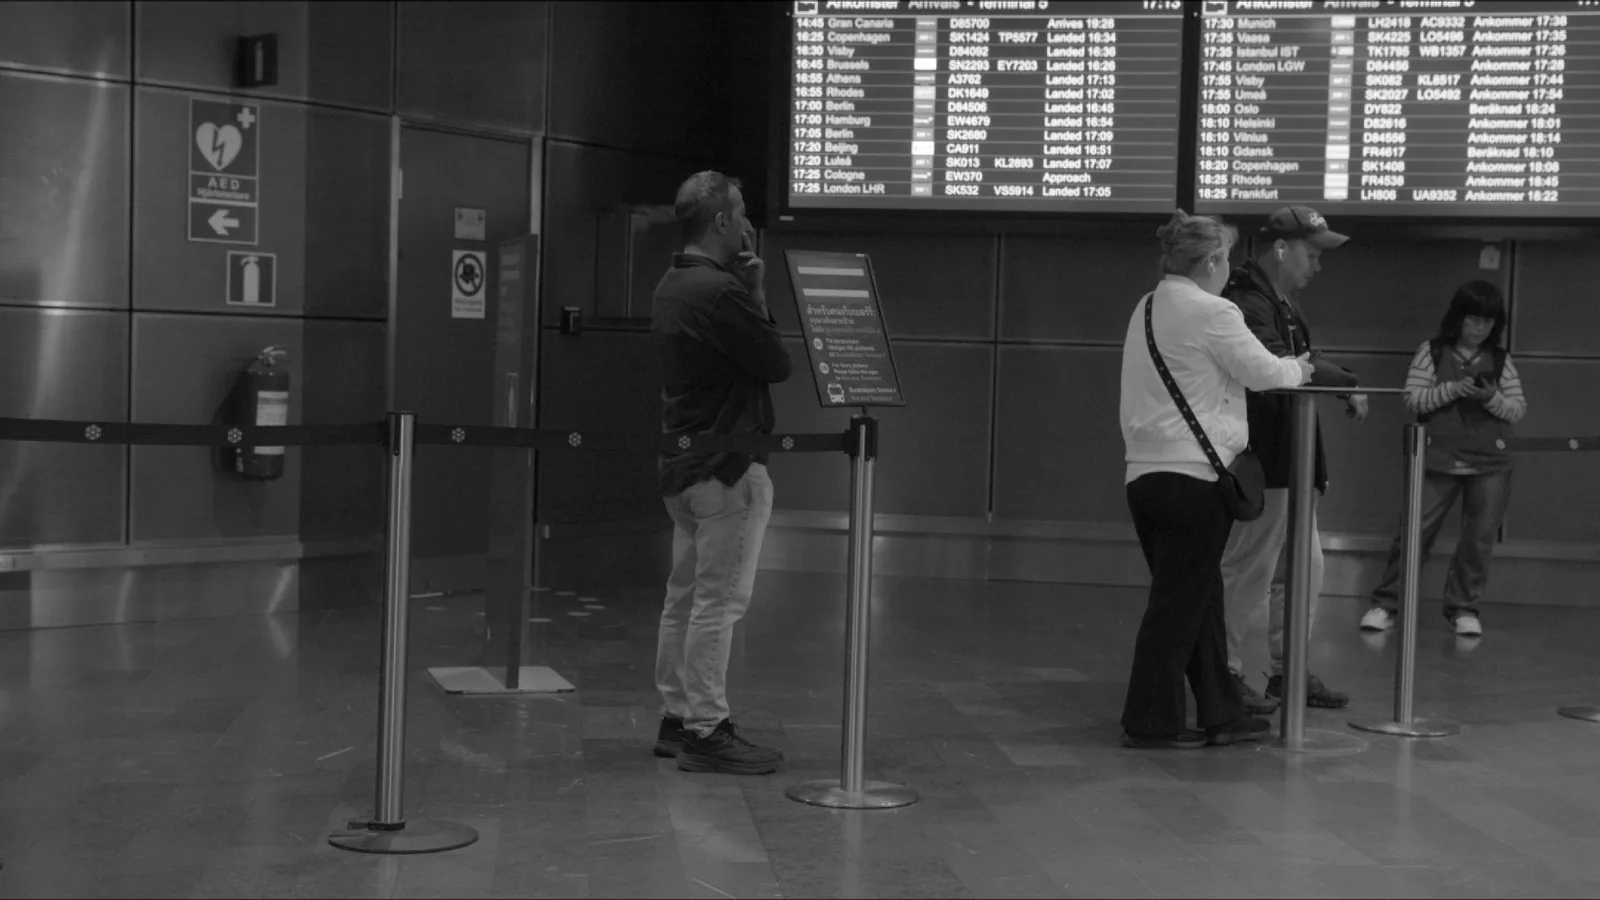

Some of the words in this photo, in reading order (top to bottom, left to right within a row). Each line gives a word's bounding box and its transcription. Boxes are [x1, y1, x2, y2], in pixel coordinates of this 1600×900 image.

[797, 18, 824, 28] 14:45
[828, 18, 852, 28] Gran
[855, 18, 893, 28] Canaria
[1048, 19, 1083, 29] Arrives
[1205, 18, 1234, 29] 17:30
[1238, 18, 1275, 29] Munich
[1474, 16, 1533, 27] Ankommer
[797, 31, 824, 41] 16:25
[828, 32, 890, 44] Copenhagen
[950, 32, 989, 43] SK1424
[1047, 33, 1084, 43] Landed
[1089, 32, 1116, 43] 16:34
[1205, 32, 1233, 43] 17:35
[1237, 32, 1270, 43] Vaasa
[1473, 31, 1533, 41] Ankommer
[797, 45, 824, 55] 16:30
[827, 46, 854, 58] Visby
[1047, 47, 1084, 57] Landed
[1204, 46, 1232, 57] 17:35
[1237, 47, 1277, 57] Istanbul
[1279, 46, 1299, 57] IST
[1472, 45, 1534, 56] Ankommer
[796, 59, 823, 69] 16:45
[827, 59, 869, 70] Brussels
[1047, 61, 1084, 71] Landed
[1204, 61, 1232, 71] 17:45
[1236, 61, 1275, 72] London
[1278, 60, 1305, 72] LGW
[1471, 60, 1531, 71] Ankommer
[796, 73, 823, 83] 16:55
[826, 73, 861, 83] Athens
[1046, 75, 1084, 85] Landed
[1087, 74, 1115, 85] 17:13
[1203, 75, 1231, 86] 17:55
[1235, 75, 1264, 87] Visby
[1471, 75, 1530, 85] Ankommer
[1534, 74, 1563, 85] 17:44
[796, 87, 822, 97] 16:55
[826, 87, 864, 97] Rhodes
[1046, 89, 1083, 99] Landed
[1087, 88, 1114, 99] 17:02
[1203, 89, 1231, 100] 17:55
[1235, 90, 1266, 100] Umeå
[1470, 89, 1530, 100] Ankommer
[1533, 88, 1563, 100] 17:54
[796, 100, 822, 111] 17:00
[826, 101, 854, 111] Berlin
[1045, 103, 1083, 113] Landed
[1087, 103, 1114, 113] 16:45
[1202, 104, 1230, 114] 18:00
[1235, 103, 1259, 114] Oslo
[1469, 104, 1522, 114] Beräknad
[795, 114, 822, 124] 17:00
[826, 115, 871, 128] Hamburg
[1045, 117, 1082, 127] Landed
[1086, 117, 1113, 127] 16:54
[1201, 118, 1229, 128] 18:10
[1234, 118, 1275, 128] Helsinki
[1469, 118, 1531, 129] Ankommer
[1531, 118, 1560, 129] 18:01
[795, 128, 821, 138] 17:05
[825, 128, 853, 138] Berlin
[1044, 131, 1082, 141] Landed
[1085, 131, 1113, 141] 17:09
[1201, 132, 1229, 142] 18:10
[1234, 132, 1268, 142] Vilnius
[1468, 133, 1530, 143] Ankommer
[1531, 132, 1560, 144] 18:14
[795, 141, 821, 152] 17:20
[825, 142, 858, 154] Beijing
[947, 144, 978, 153] CA911
[1044, 145, 1081, 155] Landed
[1085, 145, 1111, 155] 16:51
[1201, 146, 1229, 156] 18:10
[1233, 146, 1273, 156] Gdansk
[1468, 147, 1520, 158] Beräknad
[1523, 147, 1553, 158] 18:10
[794, 155, 821, 165] 17:20
[825, 156, 851, 166] Luleå
[946, 157, 980, 167] SK013
[1043, 159, 1081, 168] Landed
[1084, 159, 1112, 169] 17:07
[1200, 160, 1228, 170] 18:20
[1232, 160, 1298, 174] Copenhagen
[1467, 162, 1529, 172] Ankommer
[794, 169, 820, 179] 17:25
[824, 169, 865, 183] Cologne
[946, 171, 982, 181] EW370
[1043, 173, 1091, 184] Approach
[1199, 174, 1227, 185] 18:25
[1232, 174, 1272, 185] Rhodes
[1466, 176, 1528, 187] Ankommer
[207, 177, 240, 190] AED
[794, 183, 820, 193] 17:25
[824, 183, 860, 193] London
[863, 184, 884, 193] LHR
[945, 185, 979, 195] SK532
[994, 186, 1033, 195] VS5914
[1043, 187, 1080, 196] Landed
[1084, 187, 1111, 197] 17:05
[1199, 188, 1227, 199] 18:25
[1231, 188, 1278, 199] Frankfurt
[1465, 190, 1527, 201] Ankommer
